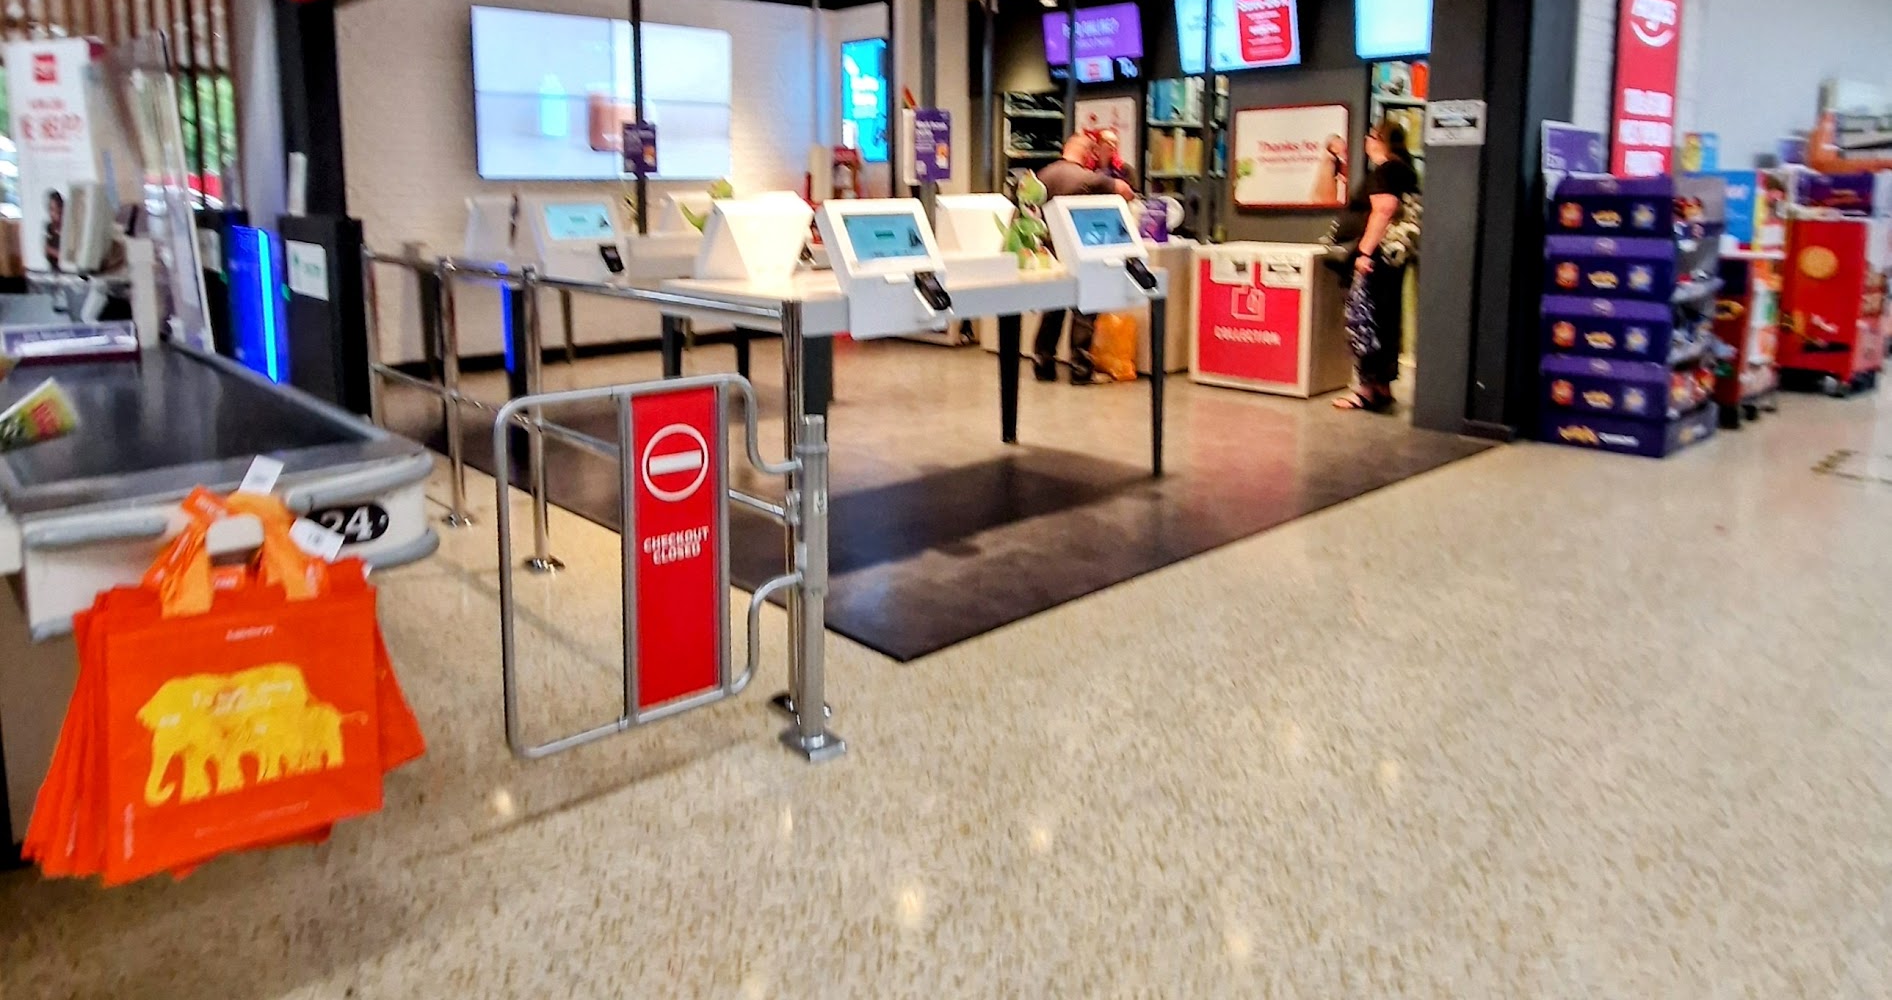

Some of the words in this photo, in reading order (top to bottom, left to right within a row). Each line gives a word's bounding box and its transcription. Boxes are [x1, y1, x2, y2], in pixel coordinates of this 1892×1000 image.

[319, 506, 373, 541] 24
[643, 525, 710, 554] CHECKOUT
[653, 541, 701, 565] CLOSED
